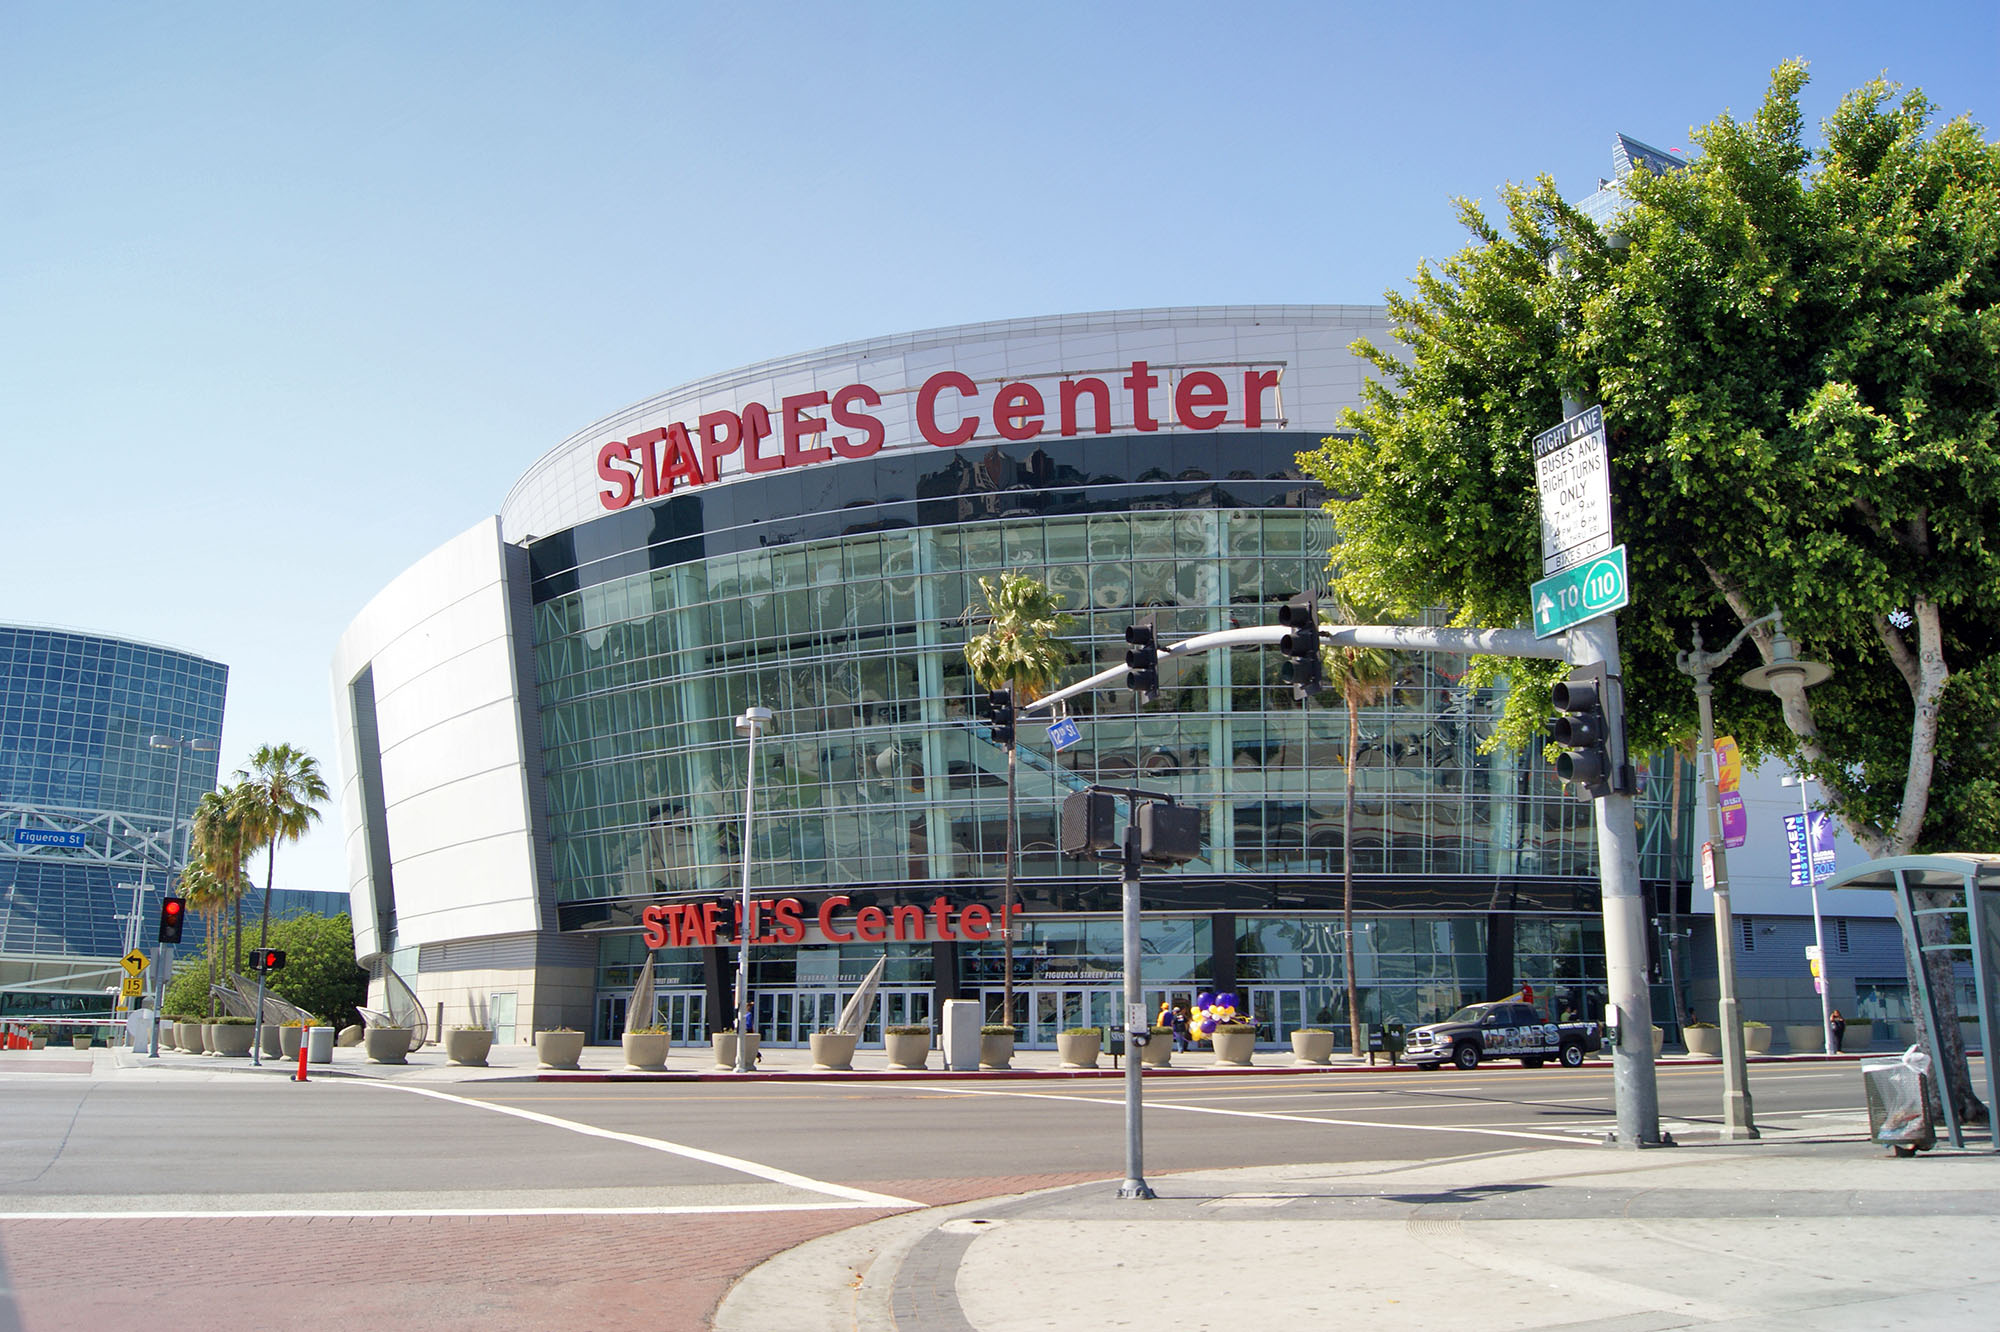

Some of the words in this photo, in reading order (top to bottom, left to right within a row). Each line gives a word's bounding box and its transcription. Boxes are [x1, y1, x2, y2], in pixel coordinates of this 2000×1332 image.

[597, 384, 885, 511] STAPLES
[915, 360, 1279, 447] Center
[1536, 426, 1567, 456] RIGHT
[1570, 410, 1600, 439] LANE
[1541, 447, 1575, 476] BUSES
[1578, 435, 1599, 459] AND
[1542, 470, 1568, 495] RIGHT
[1571, 454, 1601, 481] TURNS
[1559, 480, 1587, 506] ONLY
[1556, 548, 1582, 568] BIKES
[1586, 543, 1599, 555] OK
[1557, 584, 1579, 611] TO
[1590, 571, 1615, 601] 110
[20, 831, 65, 844] Figueroa
[69, 834, 81, 844] St
[1785, 816, 1802, 885] MILKEN
[1795, 816, 1808, 884] INSTITUTE
[1814, 862, 1836, 875] 2013
[818, 895, 1022, 942] Center
[127, 980, 140, 990] 15
[1045, 971, 1079, 979] FIGUEROA
[1080, 971, 1104, 979] STREET
[1481, 1023, 1560, 1050] WRAPS
